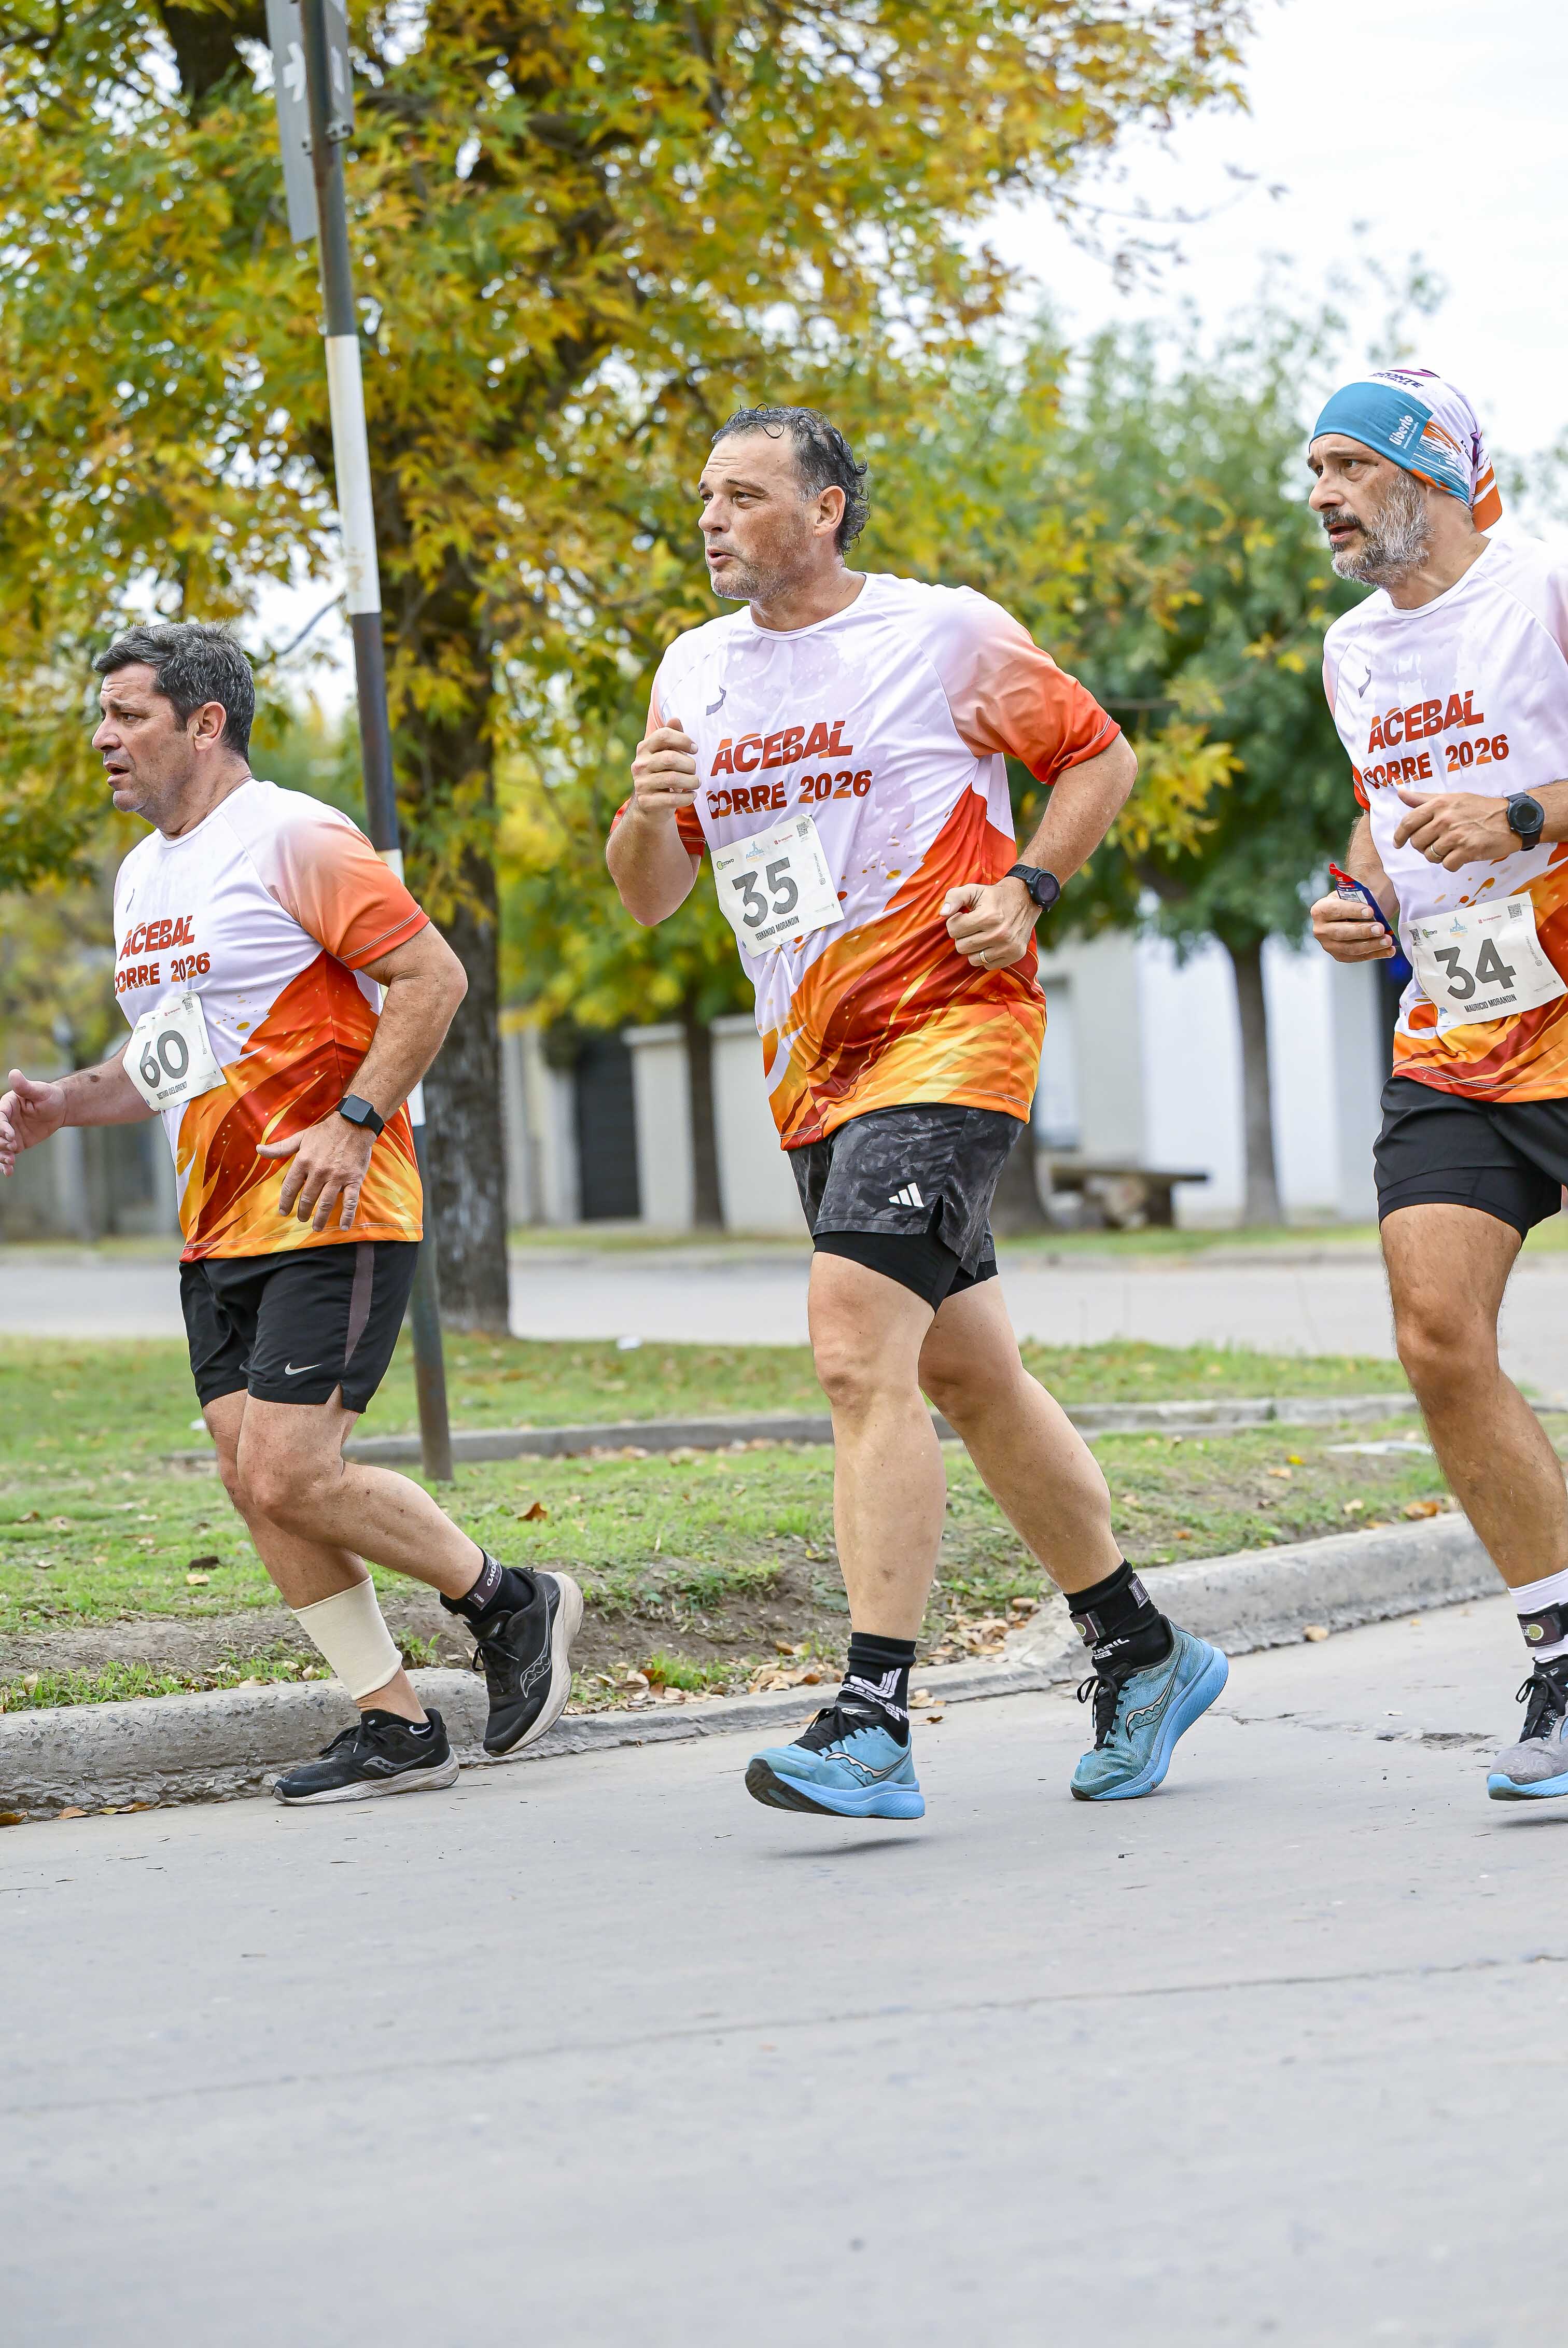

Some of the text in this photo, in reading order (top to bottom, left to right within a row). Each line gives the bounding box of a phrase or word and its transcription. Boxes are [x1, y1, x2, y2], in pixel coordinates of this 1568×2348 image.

[710, 720, 853, 777] ACEBAL
[1368, 690, 1484, 754] ACEBAL
[1363, 734, 1509, 790] CORRE 2026
[706, 770, 873, 820] CORRE 2026
[732, 857, 799, 928] 35
[119, 915, 195, 961] ACEBAL
[755, 915, 800, 941] FERNANDO MORANDIN
[171, 952, 211, 982] 2026
[1433, 938, 1517, 1000] 34
[1464, 994, 1517, 1013] MAURICIO MORANDIN
[139, 1030, 189, 1088] 60
